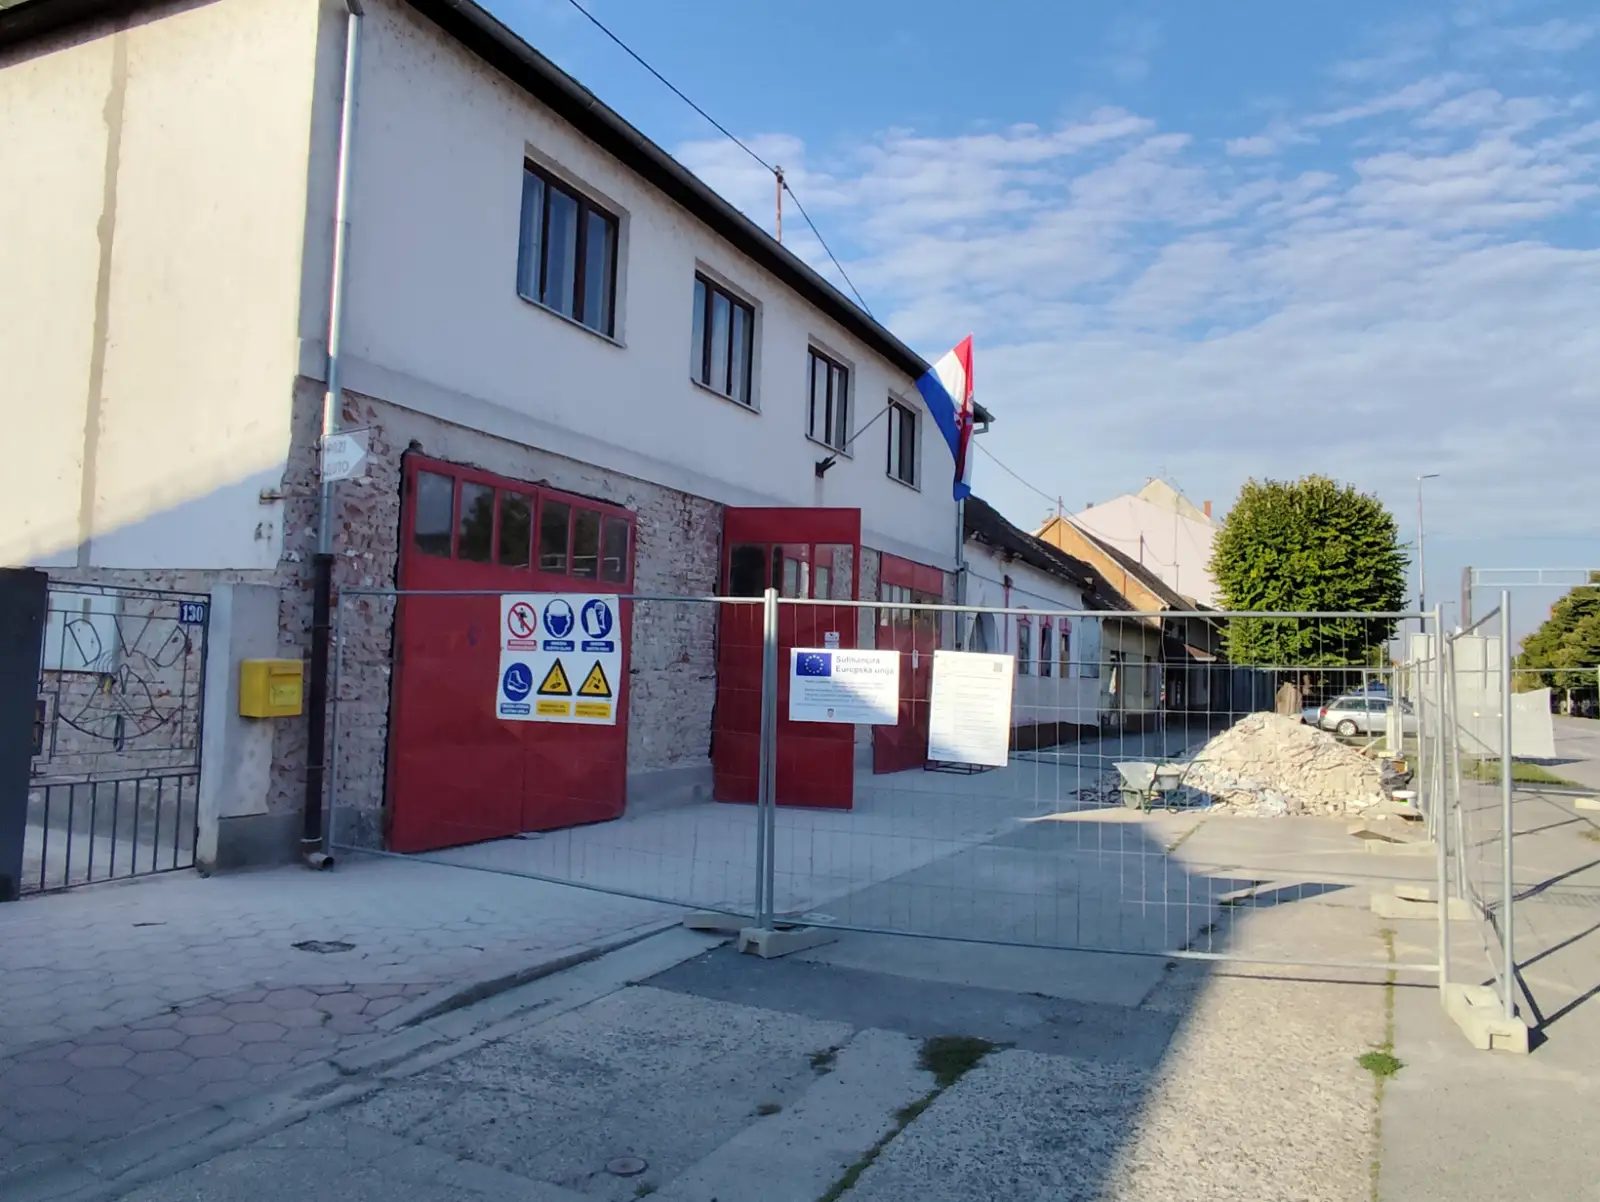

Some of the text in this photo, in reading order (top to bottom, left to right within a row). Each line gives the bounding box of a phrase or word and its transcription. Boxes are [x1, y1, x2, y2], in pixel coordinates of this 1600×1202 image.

[182, 604, 203, 622] 130
[836, 665, 894, 675] Europska unija
